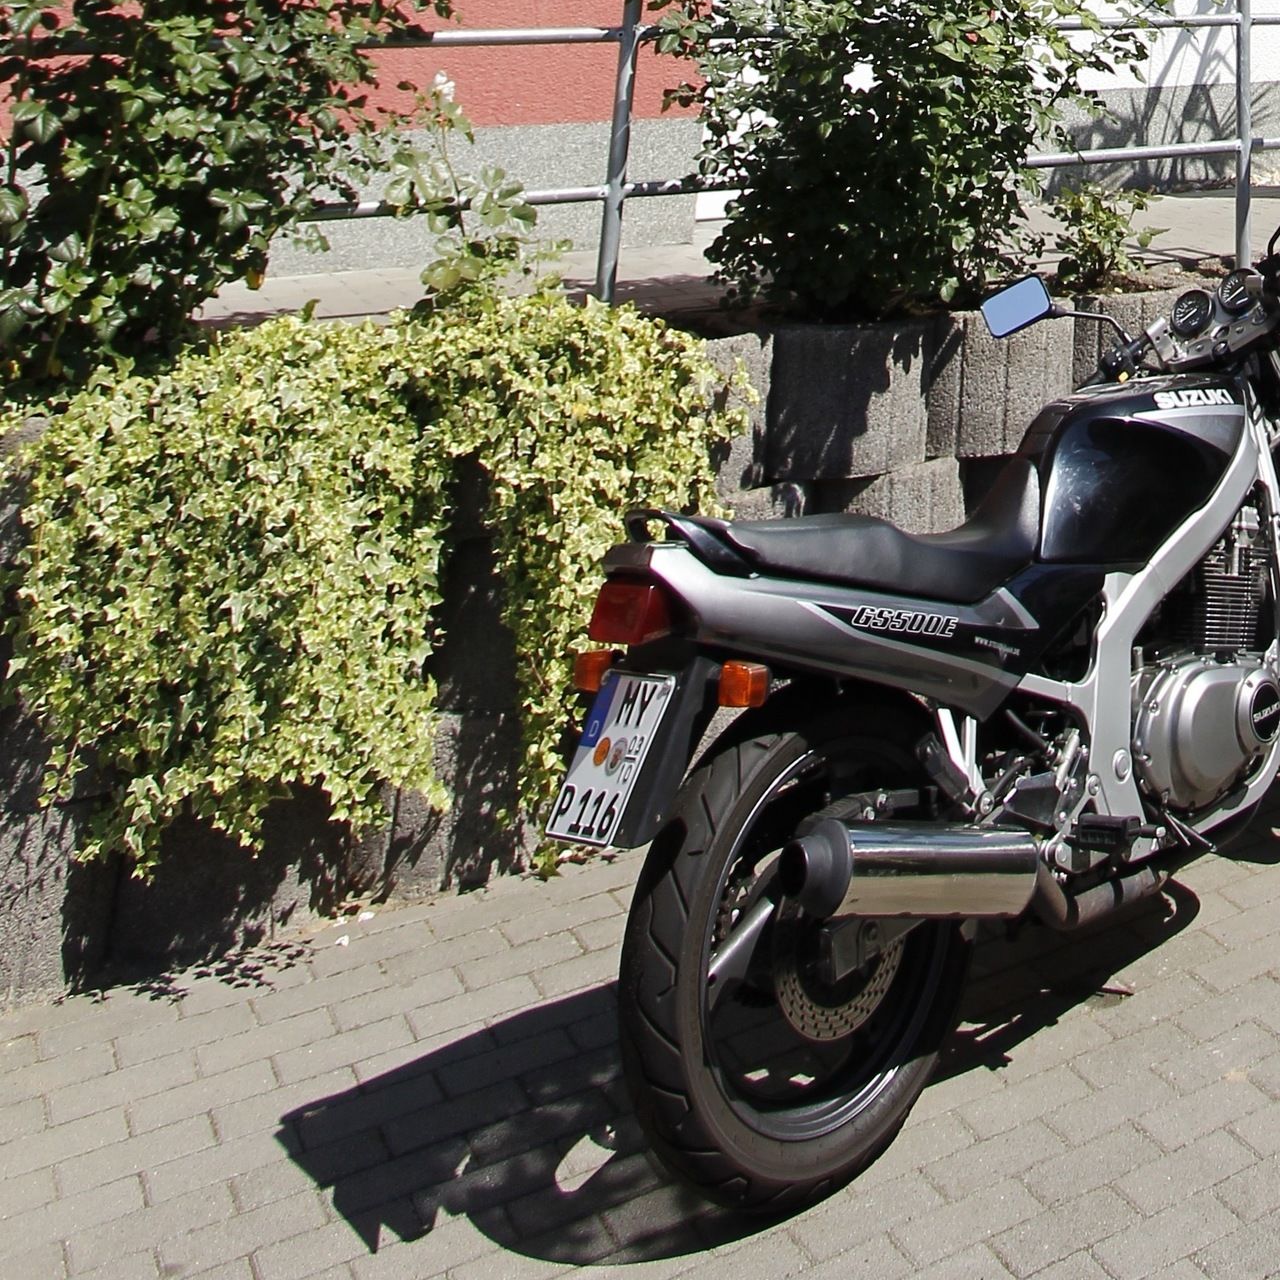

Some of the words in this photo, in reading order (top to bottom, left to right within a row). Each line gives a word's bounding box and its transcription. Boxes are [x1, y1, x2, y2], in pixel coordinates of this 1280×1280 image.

[1153, 388, 1235, 410] SUZUKI
[851, 605, 960, 638] GS500E
[614, 680, 660, 728] MY
[588, 719, 600, 738] D
[568, 788, 621, 837] 116
